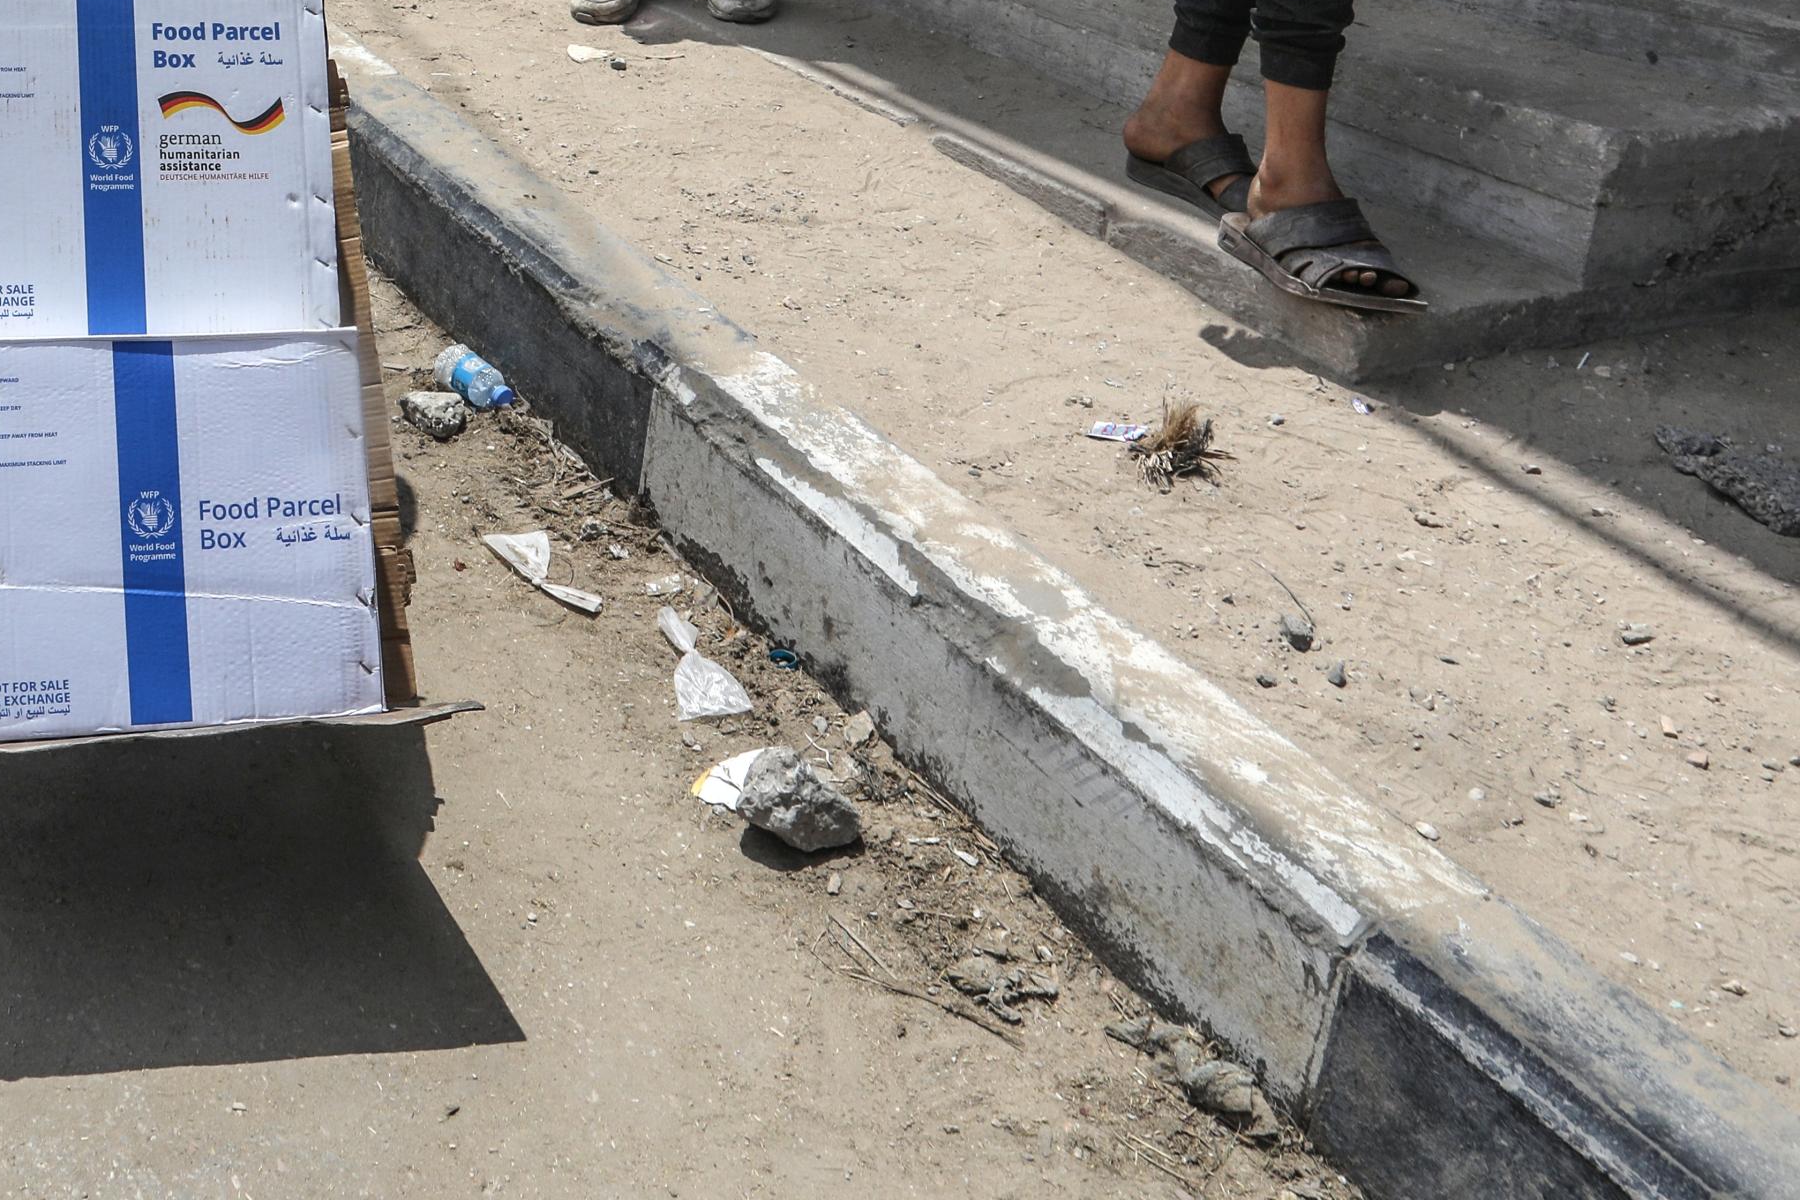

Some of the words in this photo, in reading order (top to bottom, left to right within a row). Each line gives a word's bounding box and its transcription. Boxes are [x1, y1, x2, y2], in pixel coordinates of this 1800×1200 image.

[152, 22, 206, 40] Food
[212, 22, 280, 40] Parcel
[153, 50, 196, 68] Box
[259, 51, 283, 66] سلة
[159, 133, 222, 148] german
[160, 148, 240, 160] humanitarian
[160, 161, 221, 171] assistance
[114, 173, 134, 181] Food
[199, 172, 247, 180] HUMANITÄRE
[249, 172, 269, 180] HILFE
[90, 183, 134, 191] Programme
[6, 284, 34, 294] SALE
[12, 309, 34, 319] ليست
[140, 490, 160, 499] WFP
[199, 497, 258, 521] Food
[267, 493, 341, 517] Parcel
[200, 529, 246, 550] Box
[324, 525, 351, 542] سلة
[129, 543, 154, 552] World
[155, 542, 175, 551] Food
[130, 552, 176, 563] Programme
[12, 681, 37, 693] FOR
[40, 679, 69, 691] SALE
[4, 692, 71, 706] EXCHANGE
[26, 706, 45, 720] للبيع
[47, 704, 70, 716] ليست
